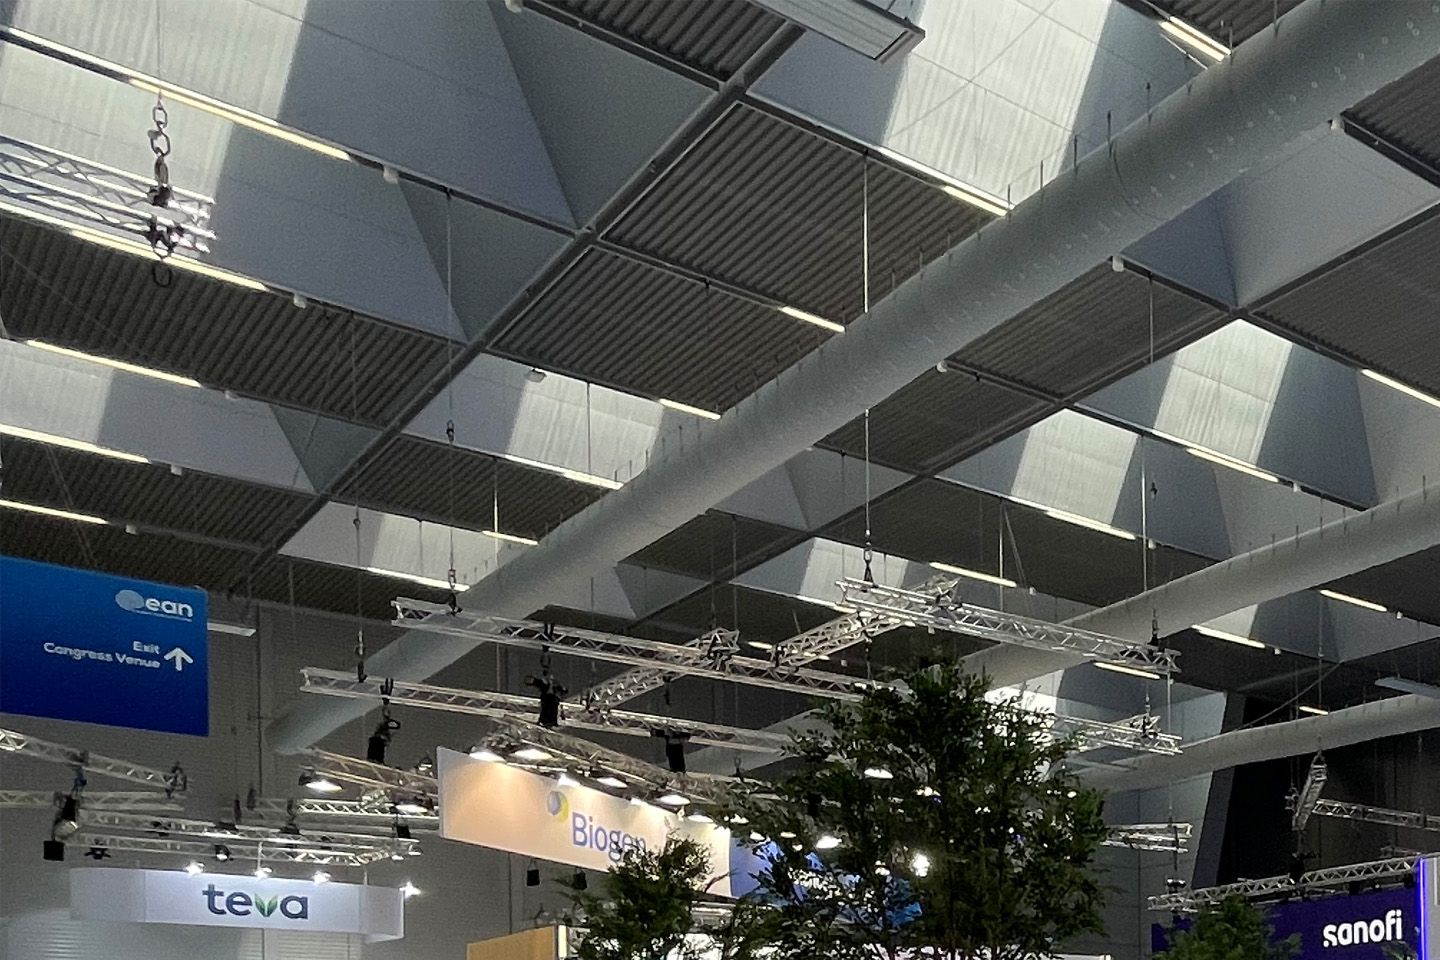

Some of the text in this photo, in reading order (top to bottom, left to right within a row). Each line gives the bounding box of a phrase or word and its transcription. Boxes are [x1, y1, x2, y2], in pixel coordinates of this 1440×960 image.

[145, 597, 194, 618] ean
[43, 642, 161, 669] Congress Venue
[133, 640, 160, 655] Exit
[202, 883, 308, 920] teva
[1323, 909, 1402, 948] sanofi
